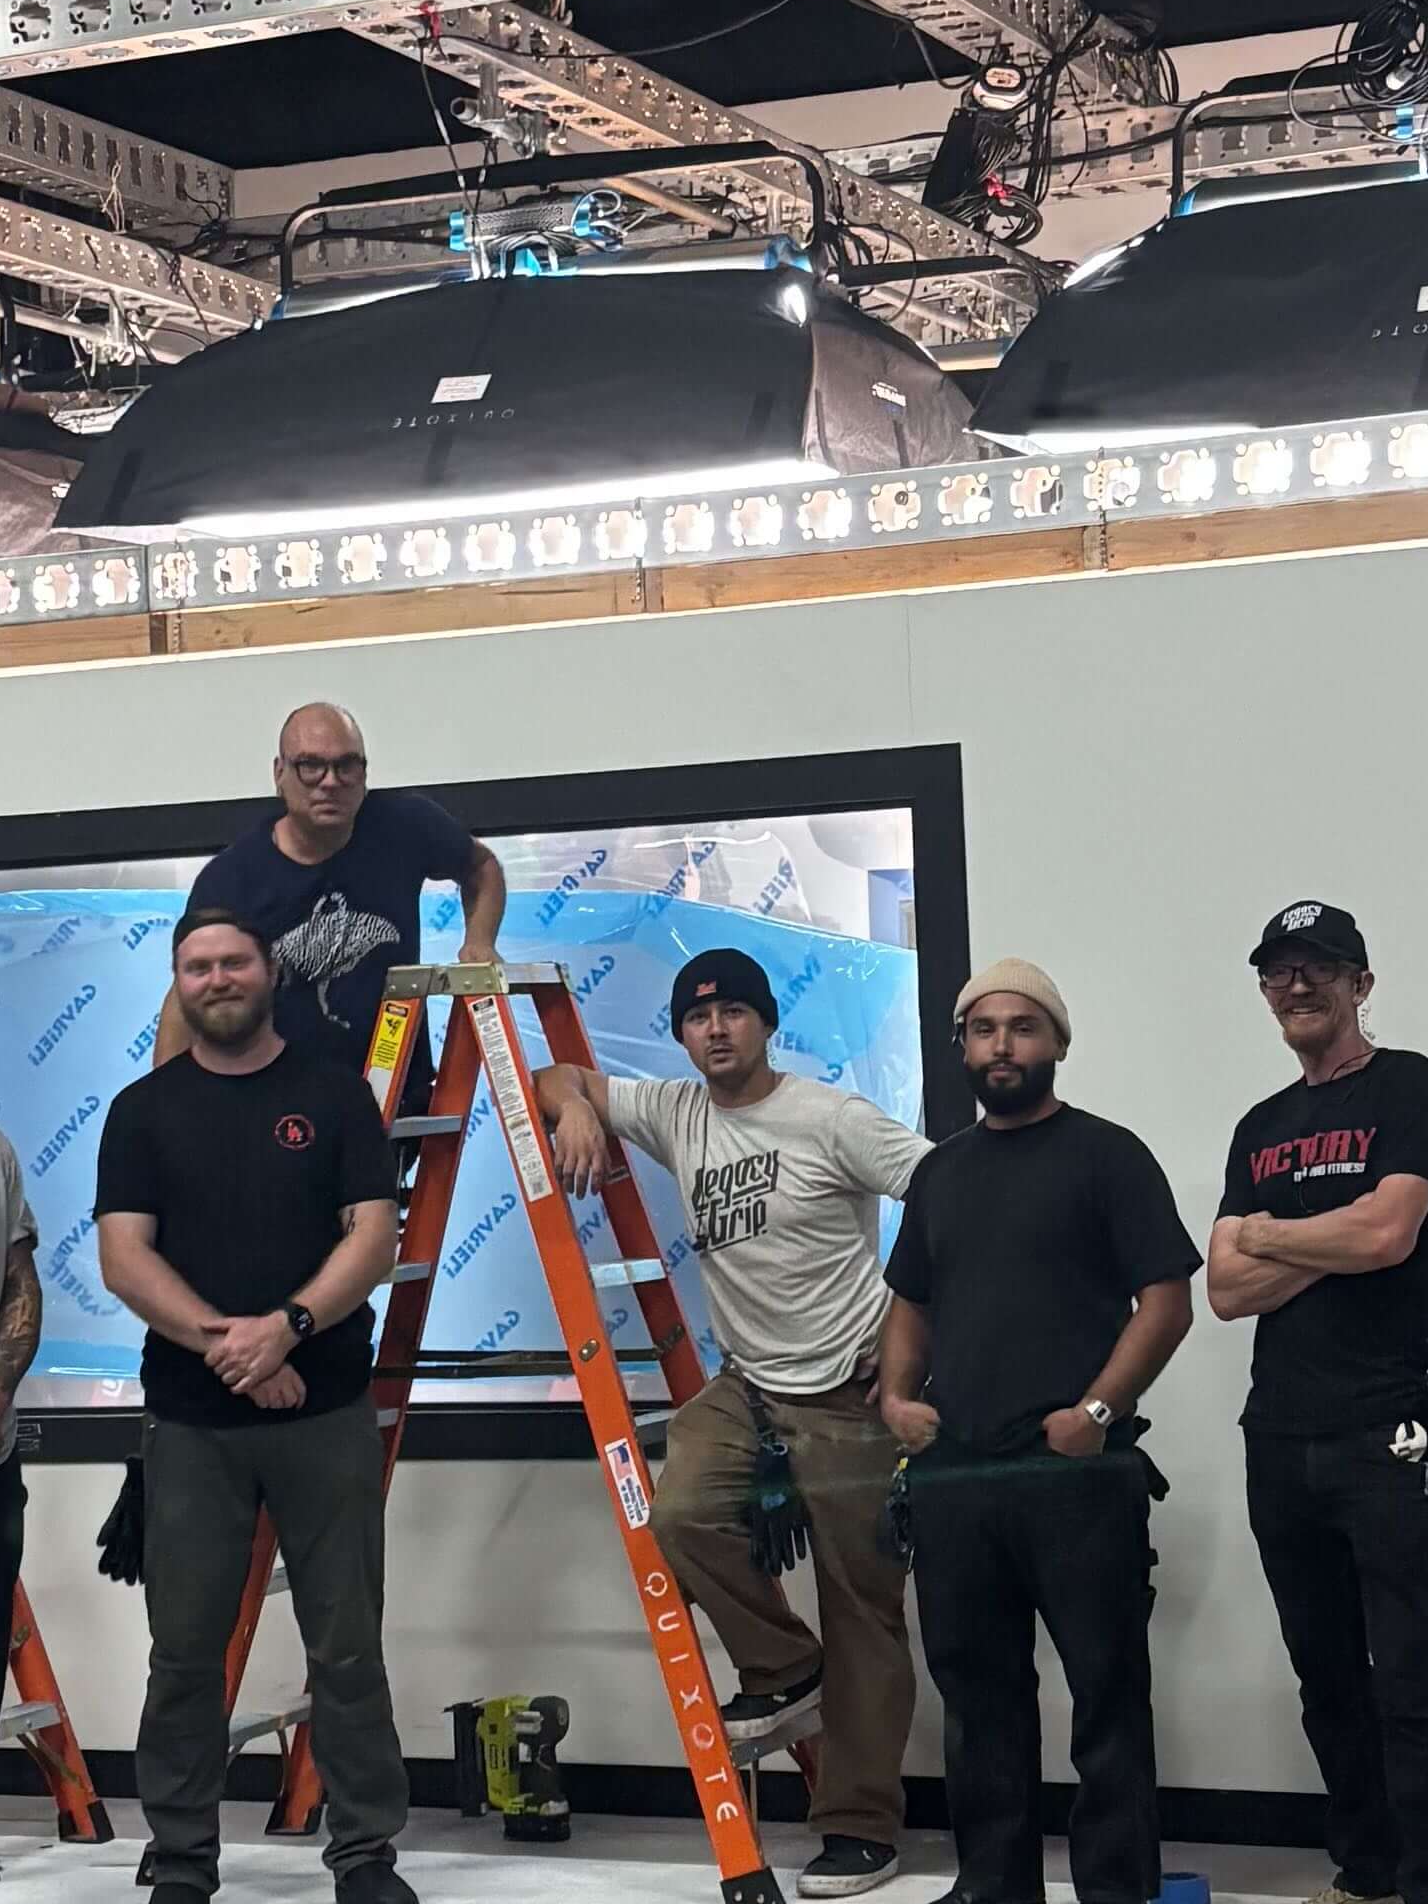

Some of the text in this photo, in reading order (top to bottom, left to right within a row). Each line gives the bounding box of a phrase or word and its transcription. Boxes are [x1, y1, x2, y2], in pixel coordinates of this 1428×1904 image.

[392, 408, 515, 429] QUIXOTE
[1250, 1127, 1376, 1185] VICTORY
[644, 1571, 739, 1822] QUIXOTE
